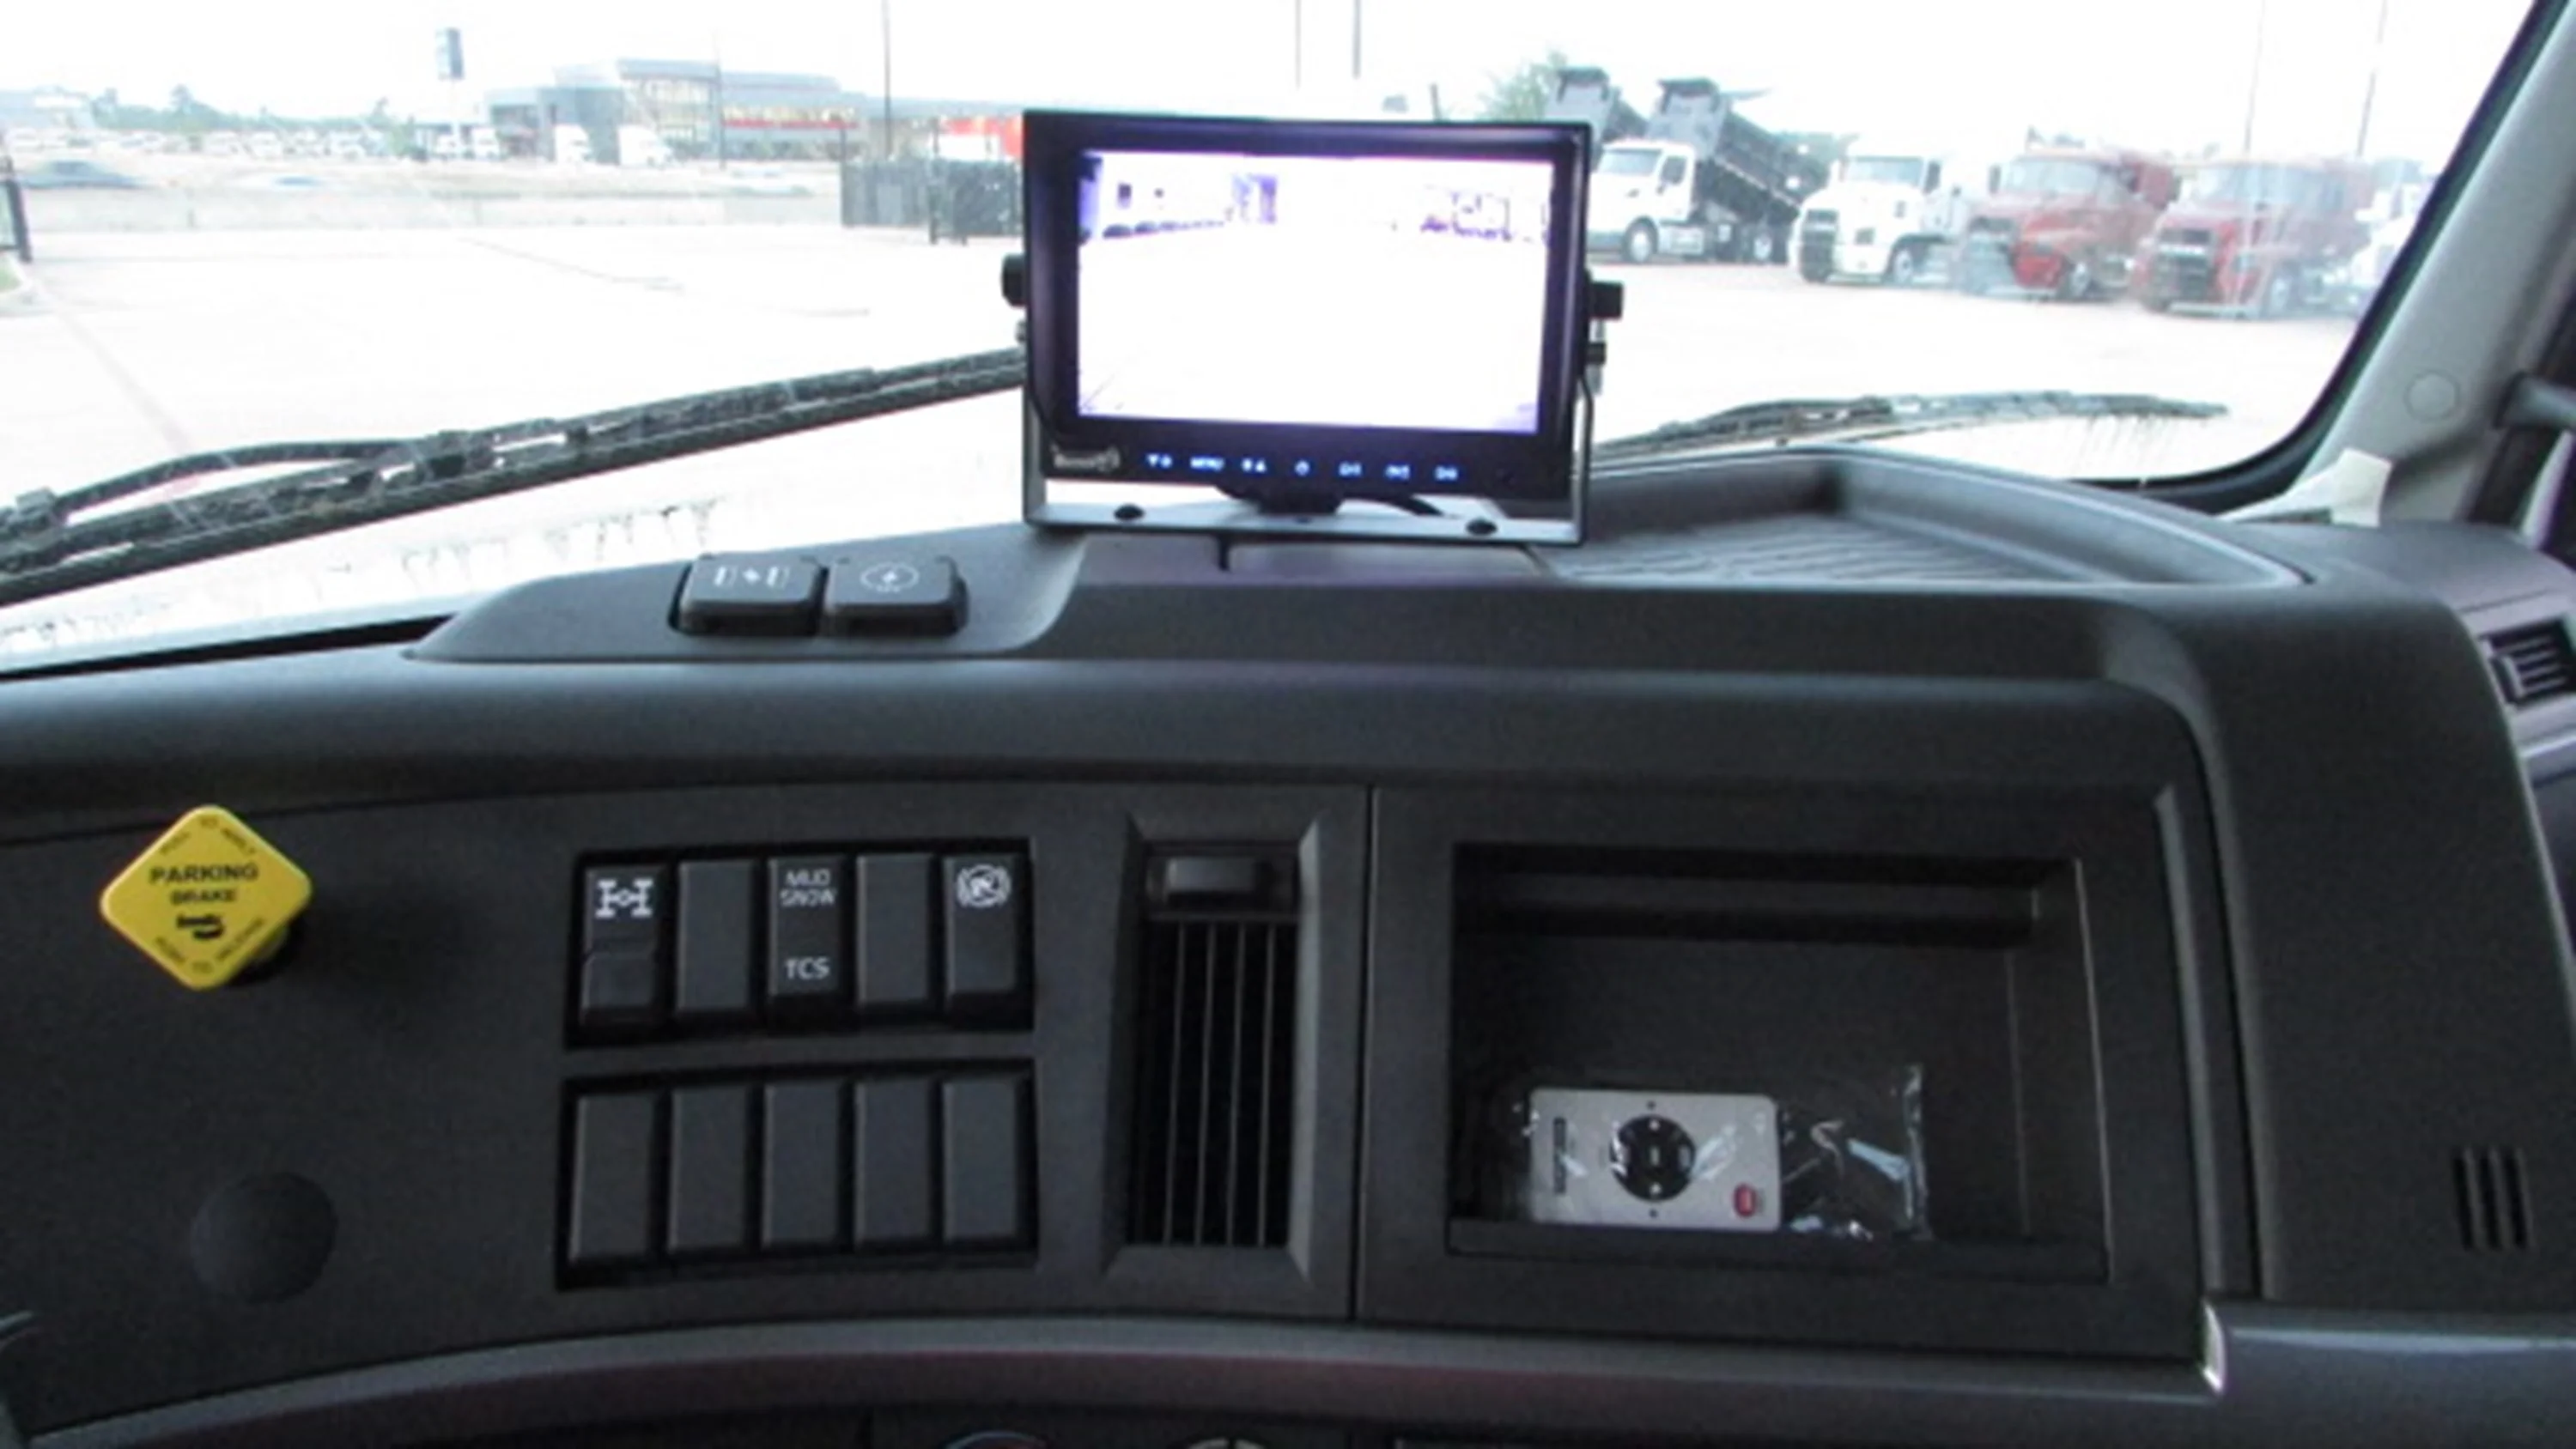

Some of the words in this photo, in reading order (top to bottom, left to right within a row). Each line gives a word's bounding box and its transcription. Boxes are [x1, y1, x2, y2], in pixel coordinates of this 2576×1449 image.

[149, 863, 259, 884] PARKING
[786, 868, 831, 887] MUD
[170, 888, 236, 906] BRAKE
[781, 888, 838, 906] SNOW
[785, 957, 830, 979] TCS
